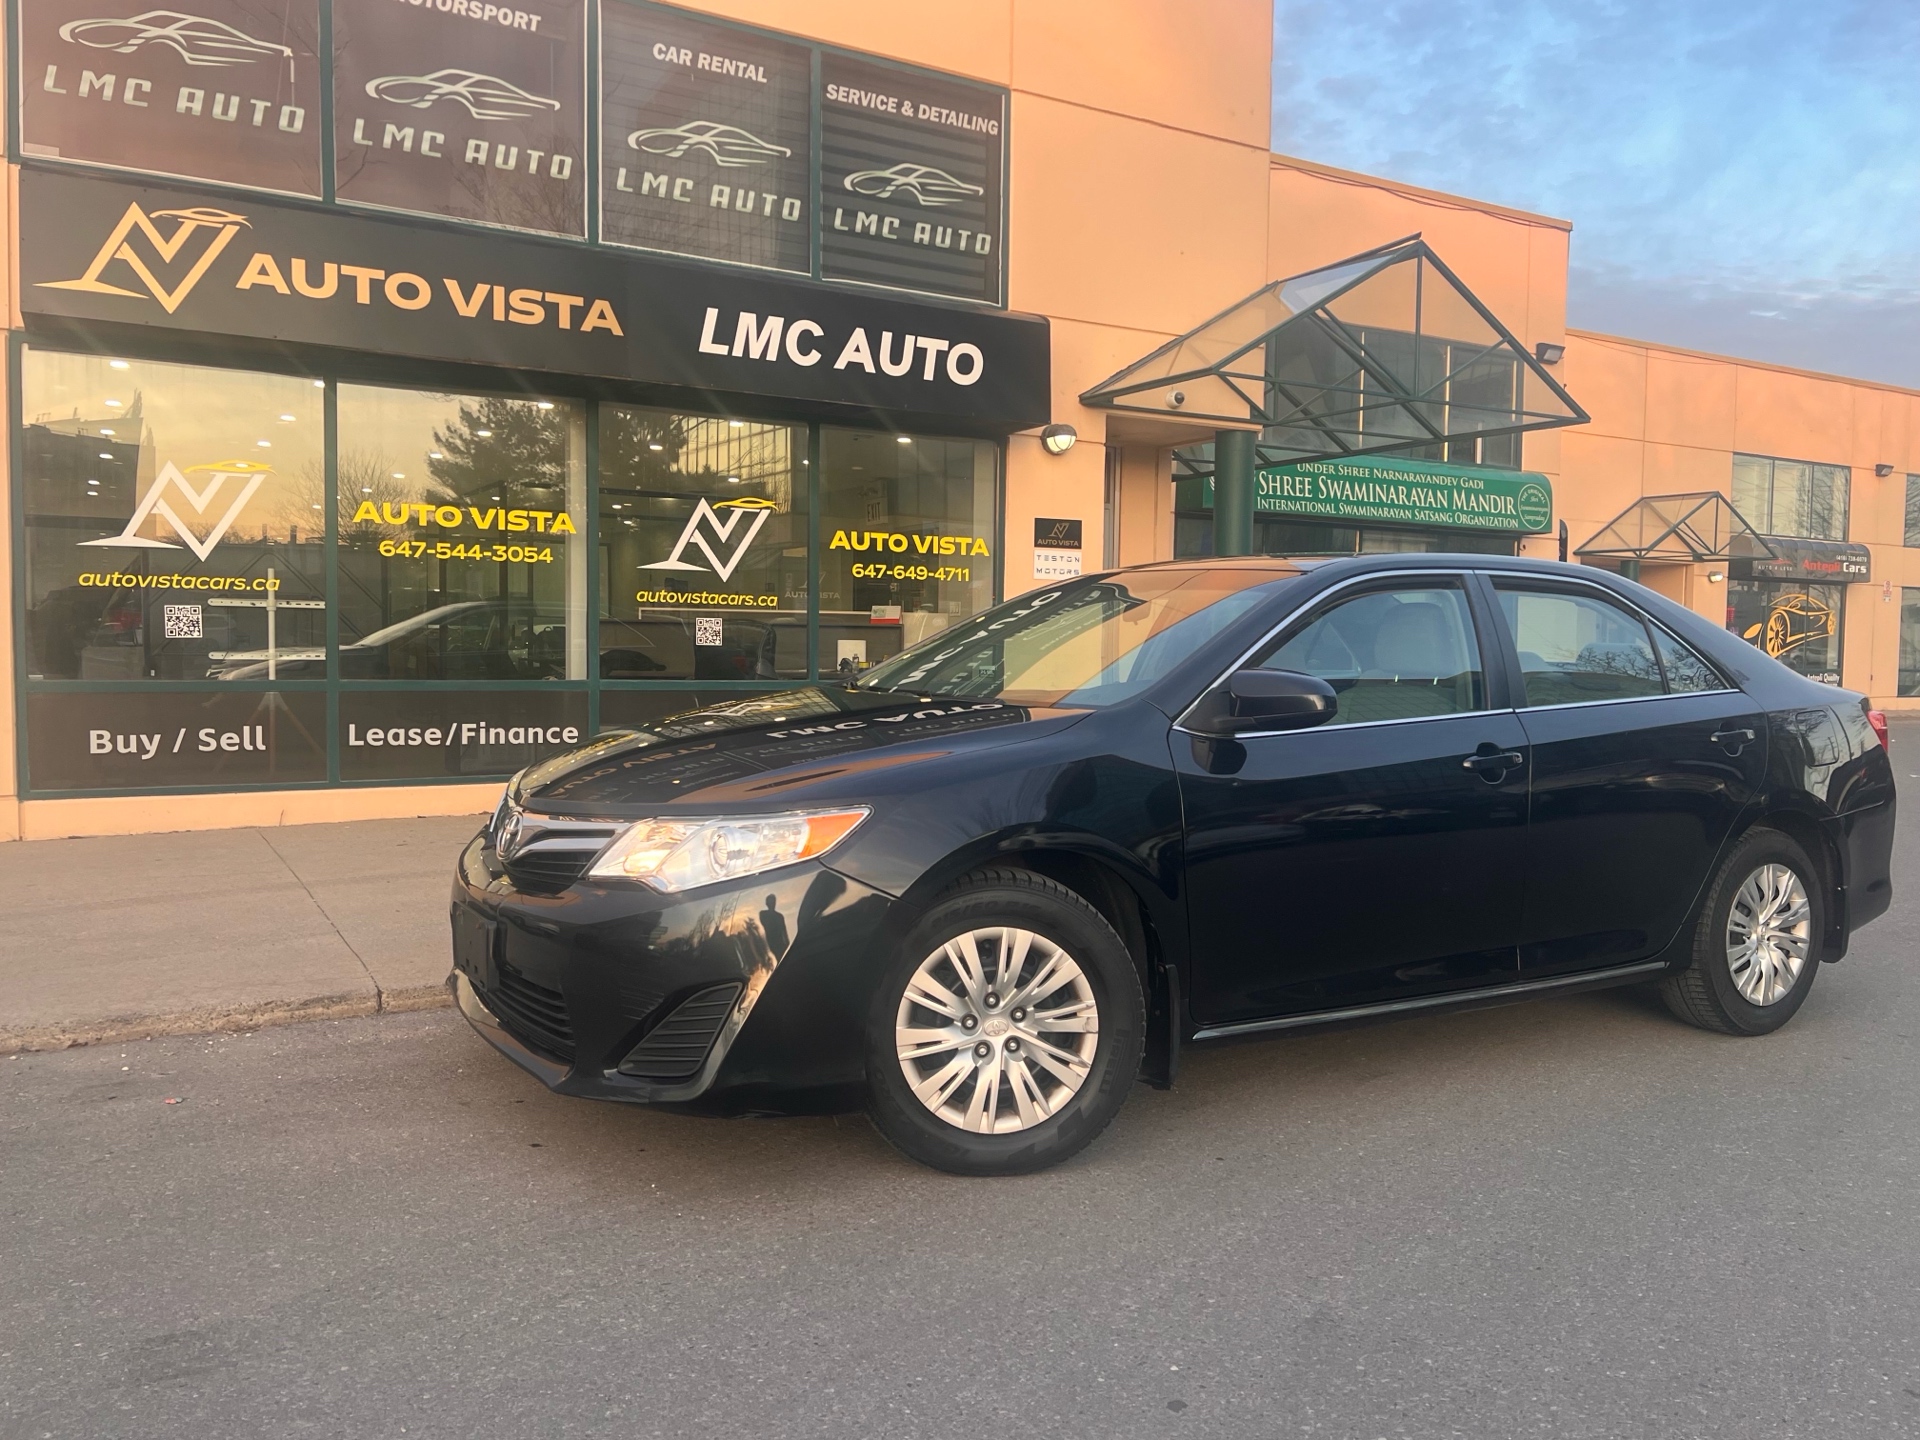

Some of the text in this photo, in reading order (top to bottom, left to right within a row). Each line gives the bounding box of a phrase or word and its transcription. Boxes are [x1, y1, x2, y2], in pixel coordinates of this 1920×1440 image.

[653, 43, 768, 84] CAR RENTAL
[43, 65, 305, 133] LMC AUTO
[826, 84, 999, 136] SERVICE & DETAILING
[353, 118, 573, 181] LMC AUTO
[616, 167, 801, 222] LMC AUTO
[833, 208, 992, 255] LMC AUTO
[235, 252, 624, 337] AUTO VISTA
[698, 307, 984, 386] LMC AUTO
[1297, 463, 1484, 489] UNDER SHREE NARNARAYANDEV GADI
[1258, 471, 1517, 515] SHREE SWAMINARAYAN MANDIR
[352, 500, 577, 534] AUTO VISTA
[867, 502, 881, 522] EXIT
[1257, 496, 1519, 529] INTERNATIONAL SWAMINARAYAN SATSANG ORGANIZATION
[379, 540, 554, 564] 647-544-3054
[829, 530, 990, 557] AUTO VISTA
[1036, 554, 1080, 563] TESTON
[78, 570, 281, 592] autovistacars.ca
[852, 563, 970, 582] 647-649-4711
[1036, 567, 1080, 575] MOTORS
[1842, 562, 1868, 574] Cars
[636, 589, 778, 608] autovistacars.ca
[88, 725, 267, 760] Buy / Sell
[347, 721, 580, 747] Lease/Finance
